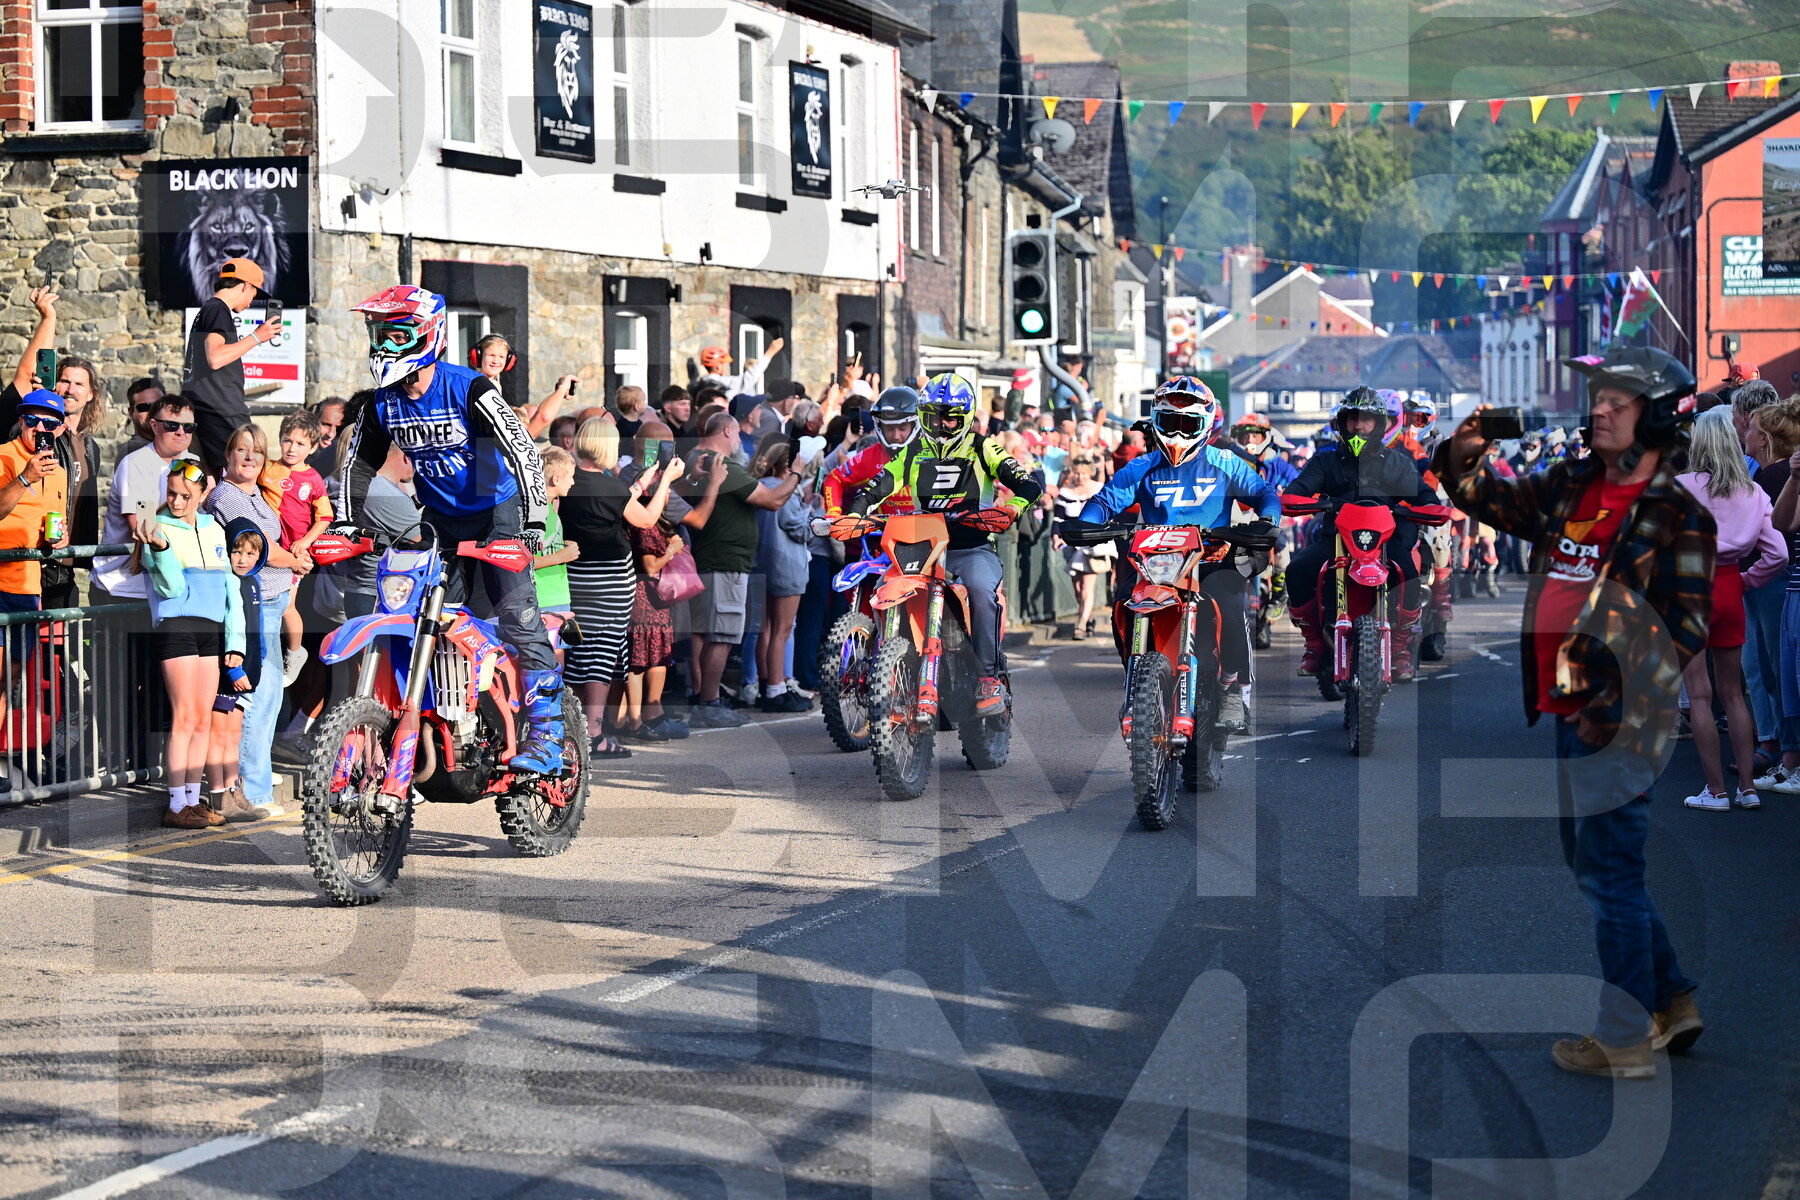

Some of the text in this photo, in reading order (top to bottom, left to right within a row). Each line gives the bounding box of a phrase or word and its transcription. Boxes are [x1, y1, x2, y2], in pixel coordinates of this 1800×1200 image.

[169, 166, 298, 192] BLACK LION
[373, 301, 408, 310] AIROH
[416, 310, 445, 336] 100%
[1154, 485, 1217, 507] FLY
[1139, 531, 1190, 549] 45
